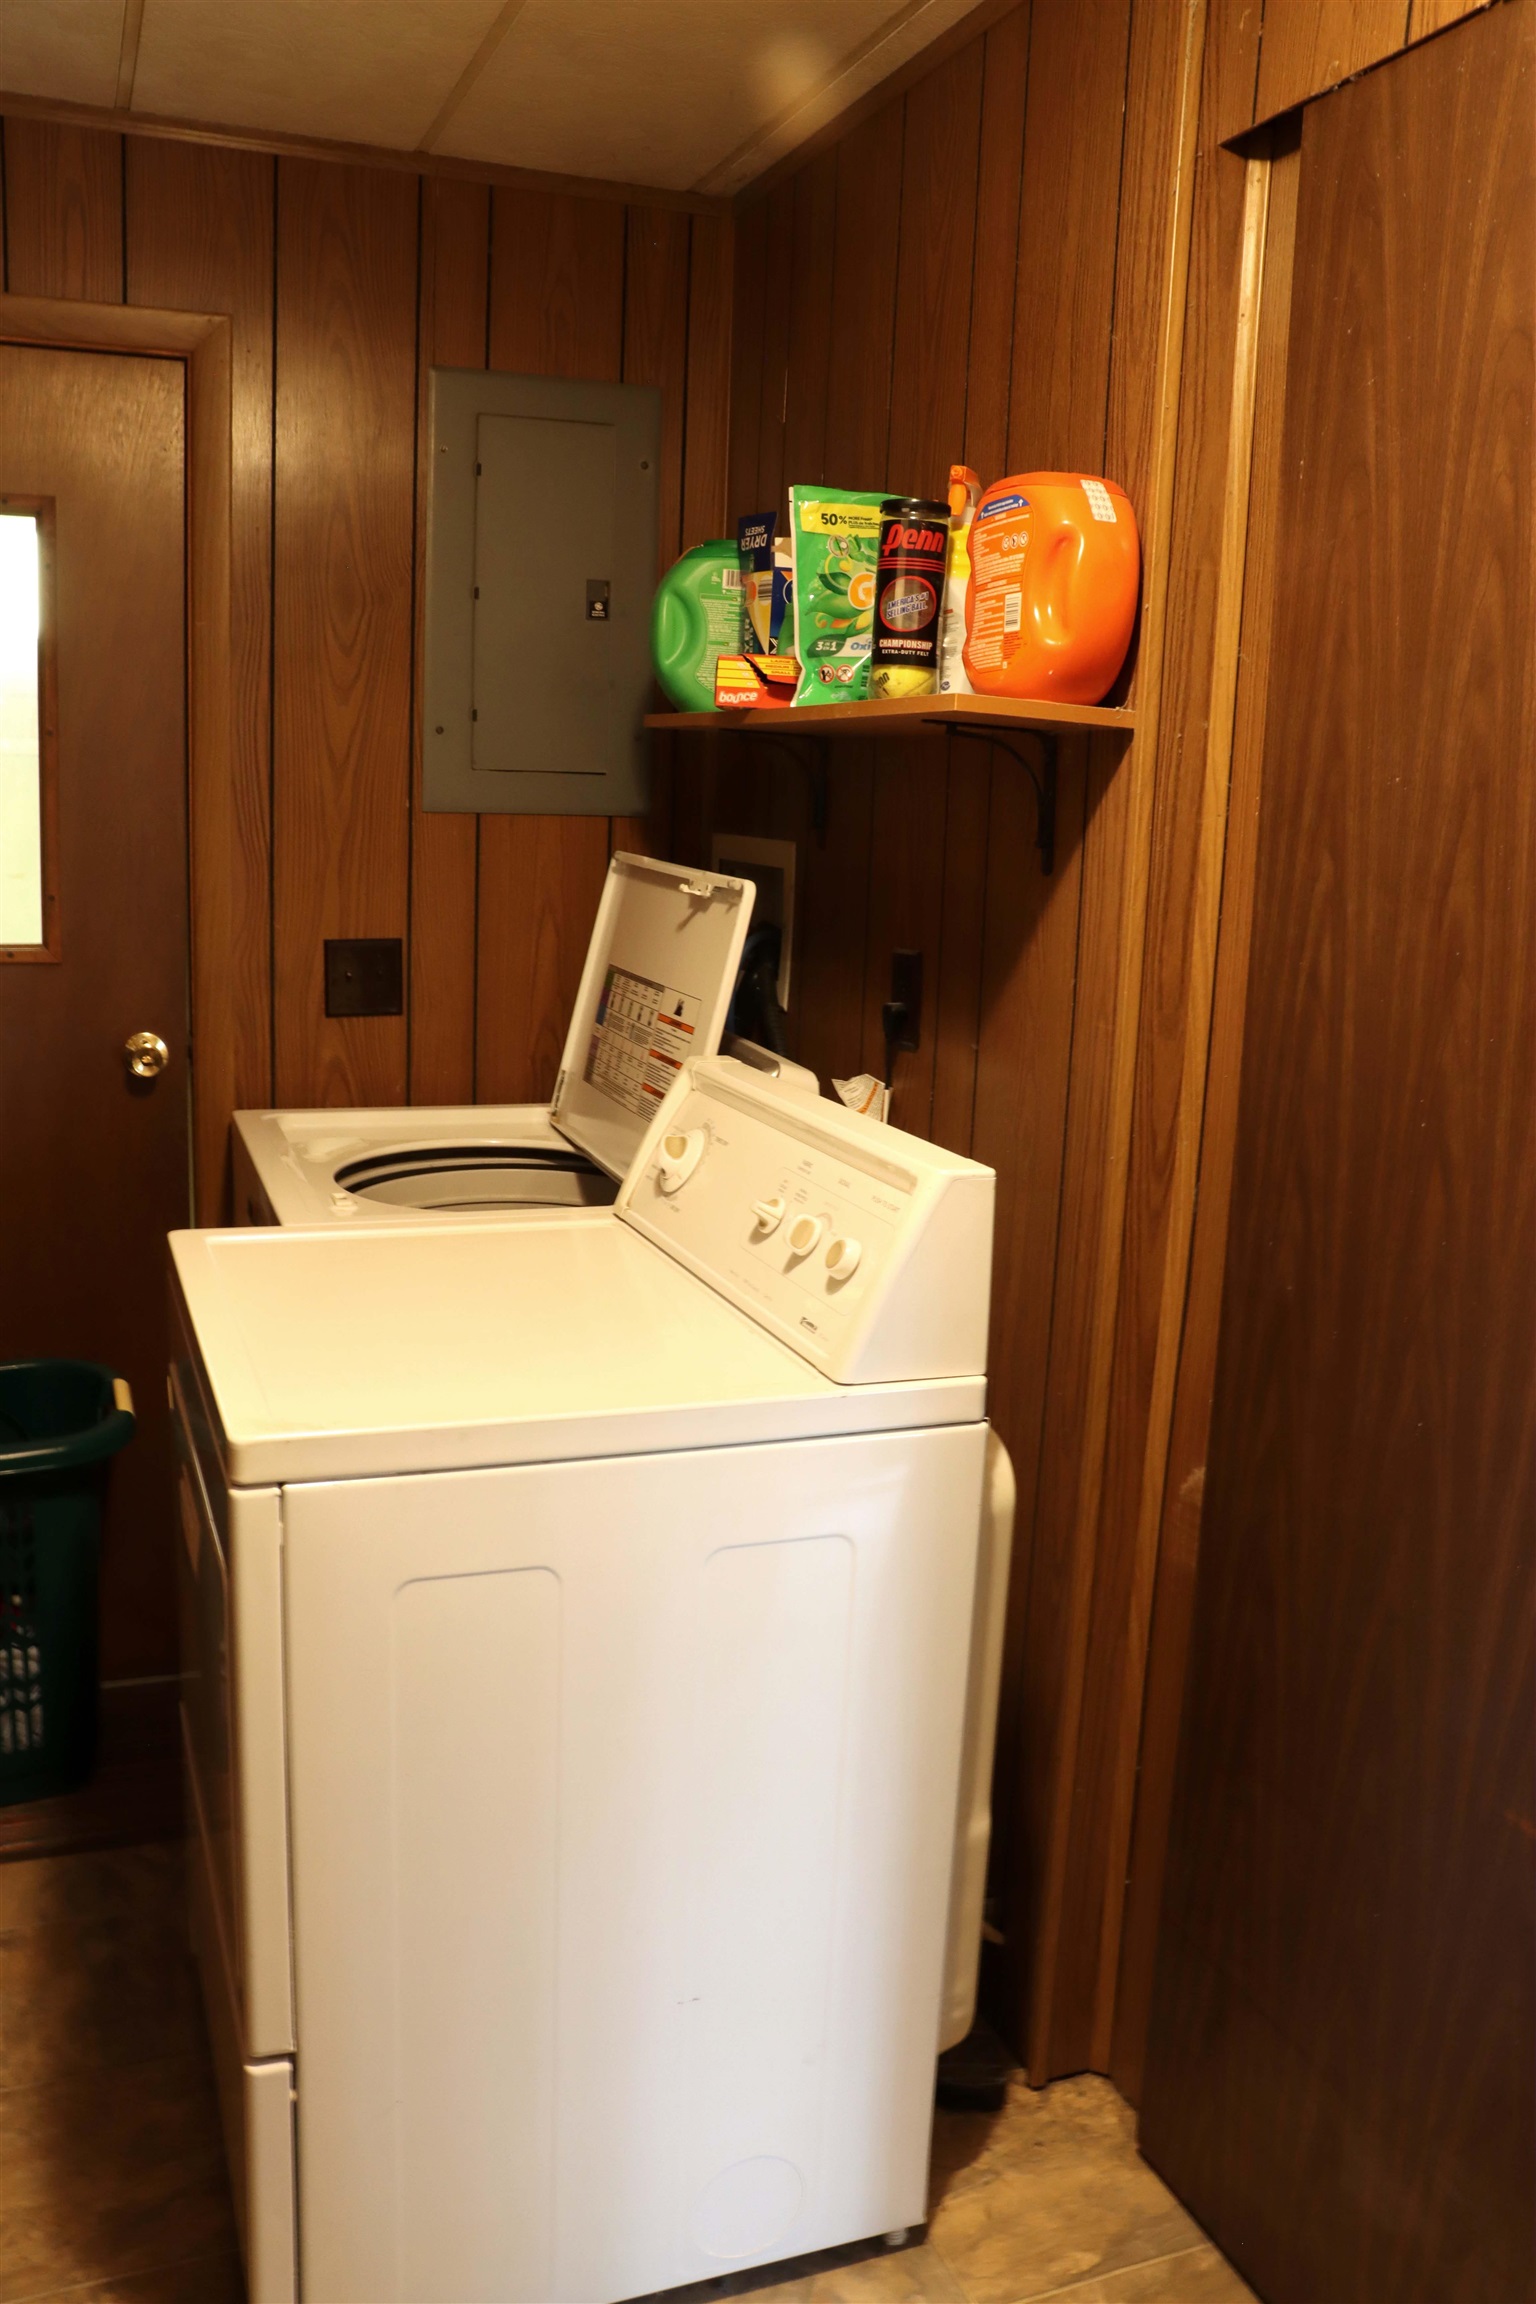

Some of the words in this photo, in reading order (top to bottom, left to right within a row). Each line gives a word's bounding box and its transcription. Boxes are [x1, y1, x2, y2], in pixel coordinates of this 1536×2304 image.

[745, 525, 765, 536] SHEETS
[741, 533, 767, 551] DRYER
[886, 603, 911, 619] SELLING
[816, 641, 824, 651] 3
[830, 641, 837, 651] 1
[879, 638, 933, 651] CHAMPIONSHIP
[718, 691, 758, 703] bounce
